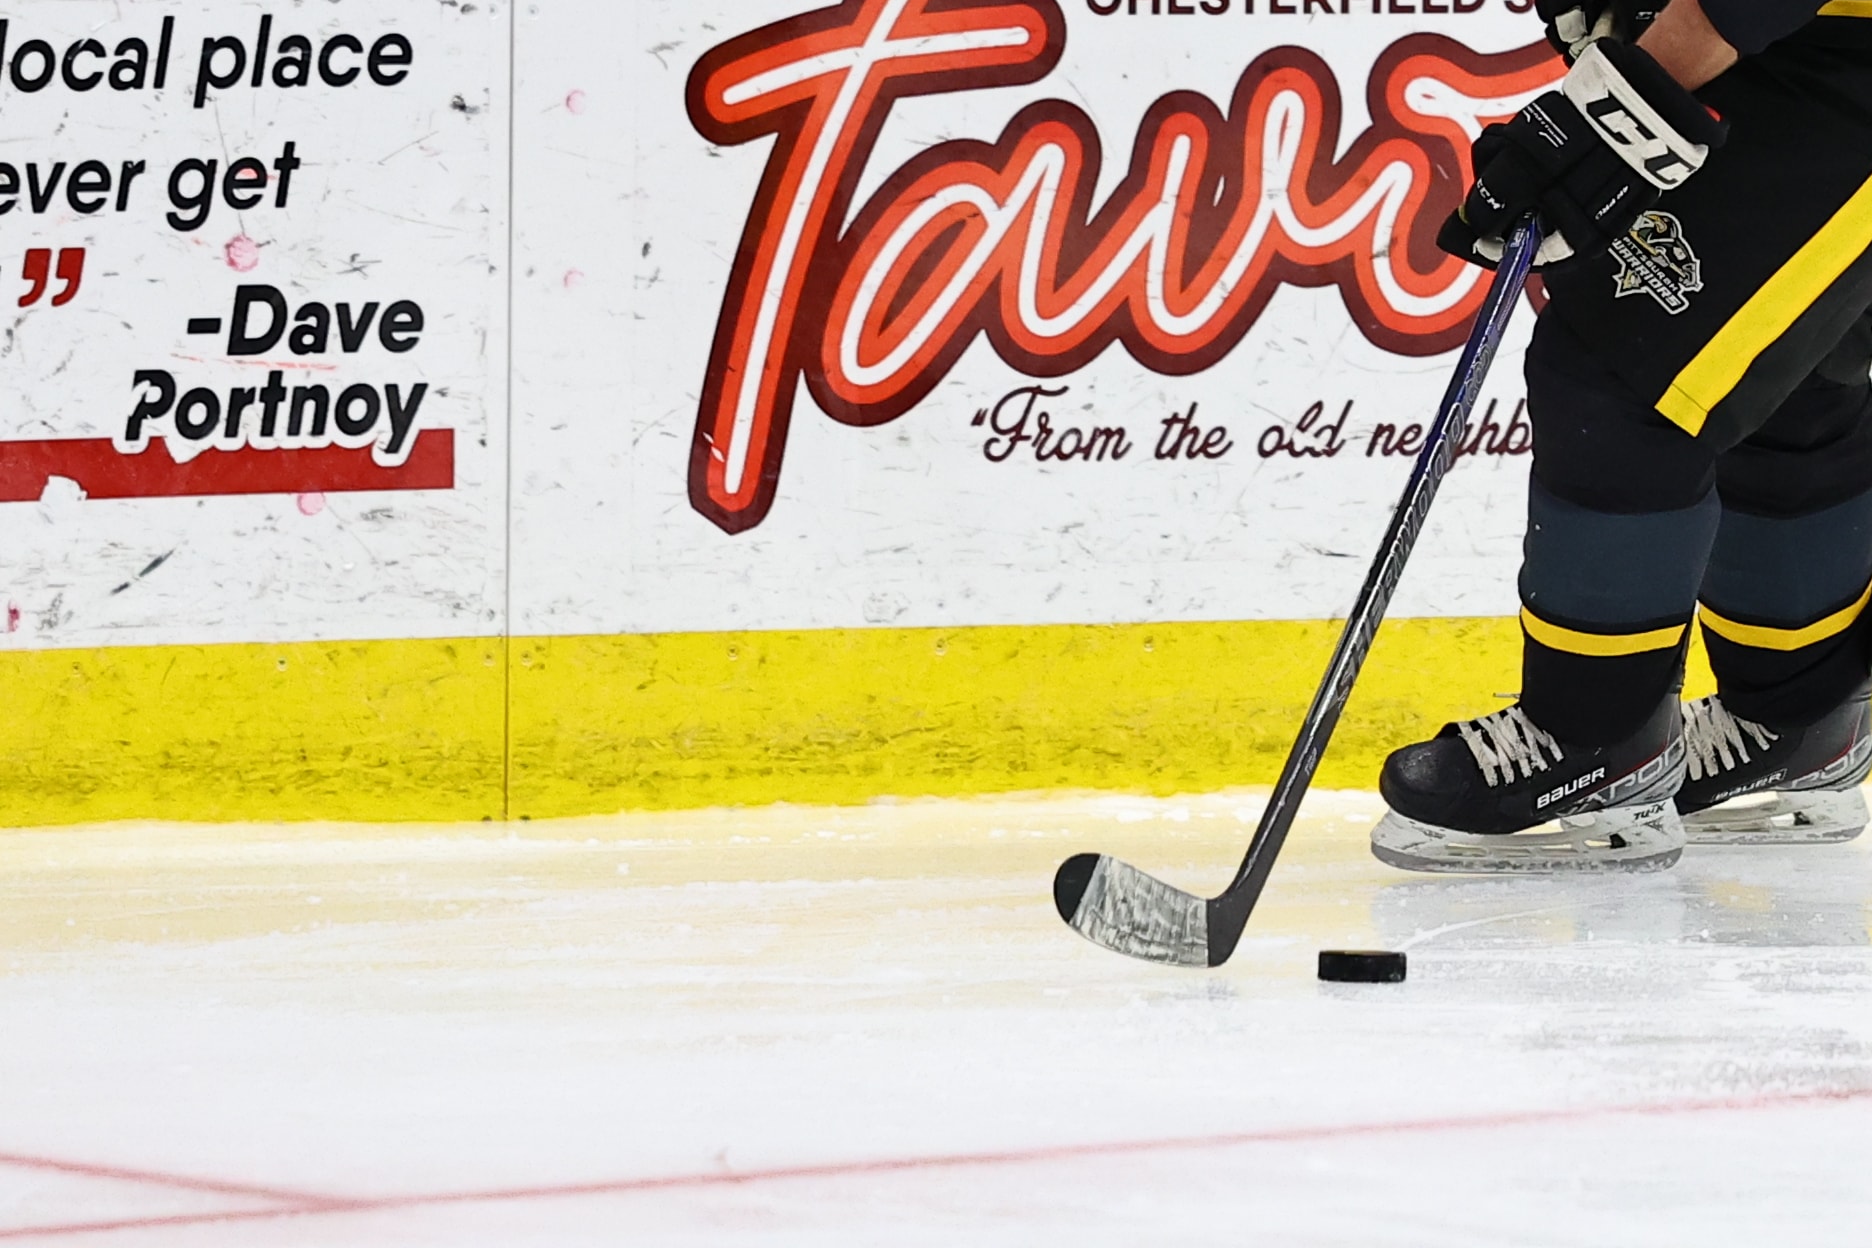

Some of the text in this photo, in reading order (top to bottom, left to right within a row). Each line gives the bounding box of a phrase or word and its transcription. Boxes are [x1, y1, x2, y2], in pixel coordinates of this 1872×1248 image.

[194, 15, 412, 108] place
[167, 142, 300, 231] get
[1611, 238, 1682, 307] WARRIORS
[188, 285, 424, 356] -Dave
[126, 369, 427, 454] Portnoy
[1155, 401, 1233, 460] the
[1258, 399, 1354, 459] old
[1537, 766, 1605, 810] BAUER
